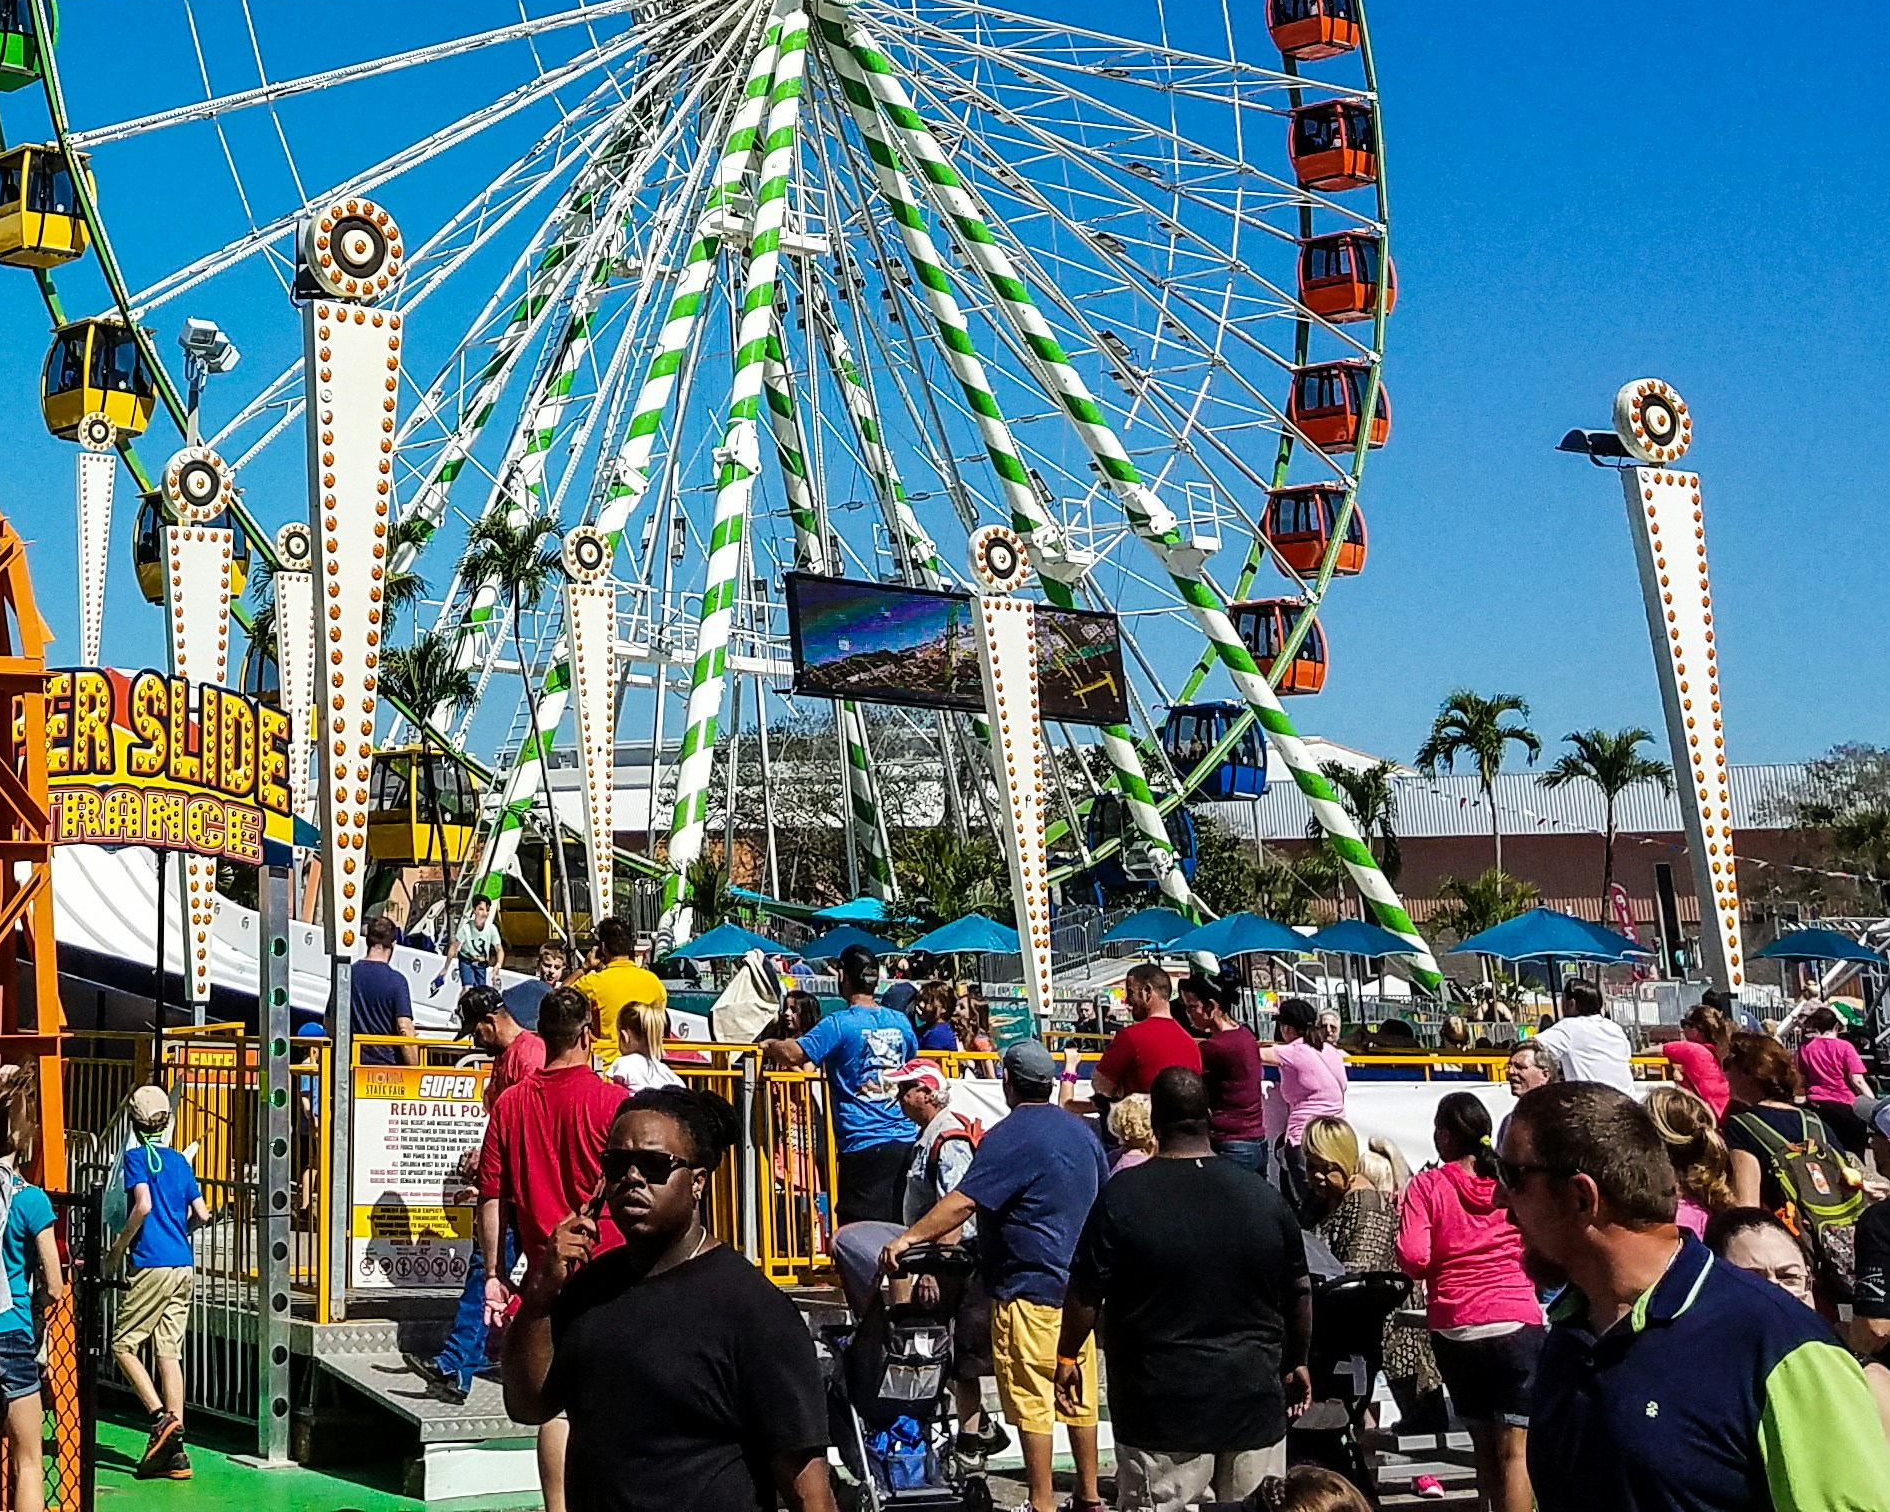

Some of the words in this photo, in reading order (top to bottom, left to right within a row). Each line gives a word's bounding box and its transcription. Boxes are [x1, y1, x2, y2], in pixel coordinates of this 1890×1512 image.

[128, 669, 292, 816] SLIDE
[190, 1052, 237, 1074] ENTE
[366, 1085, 387, 1095] STATE
[388, 1085, 405, 1096] FAIR
[419, 1074, 477, 1099] SUPER
[390, 1103, 427, 1116] READ
[432, 1104, 457, 1117] ALL
